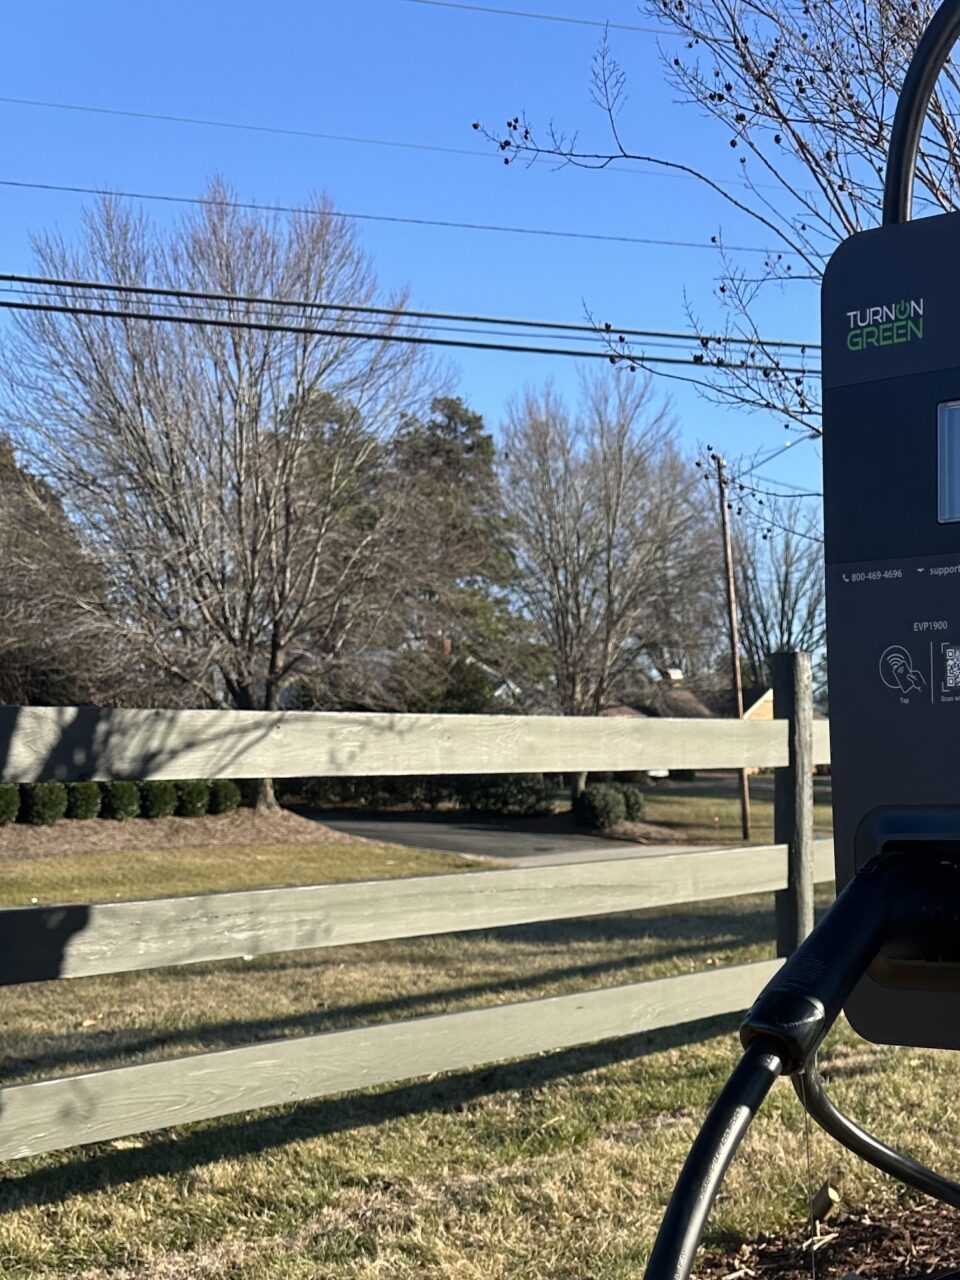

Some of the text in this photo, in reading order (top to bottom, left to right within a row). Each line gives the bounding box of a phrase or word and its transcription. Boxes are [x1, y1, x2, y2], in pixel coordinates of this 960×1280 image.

[847, 298, 924, 328] TURNON
[847, 318, 924, 351] GREEN
[913, 620, 948, 632] EVP1900
